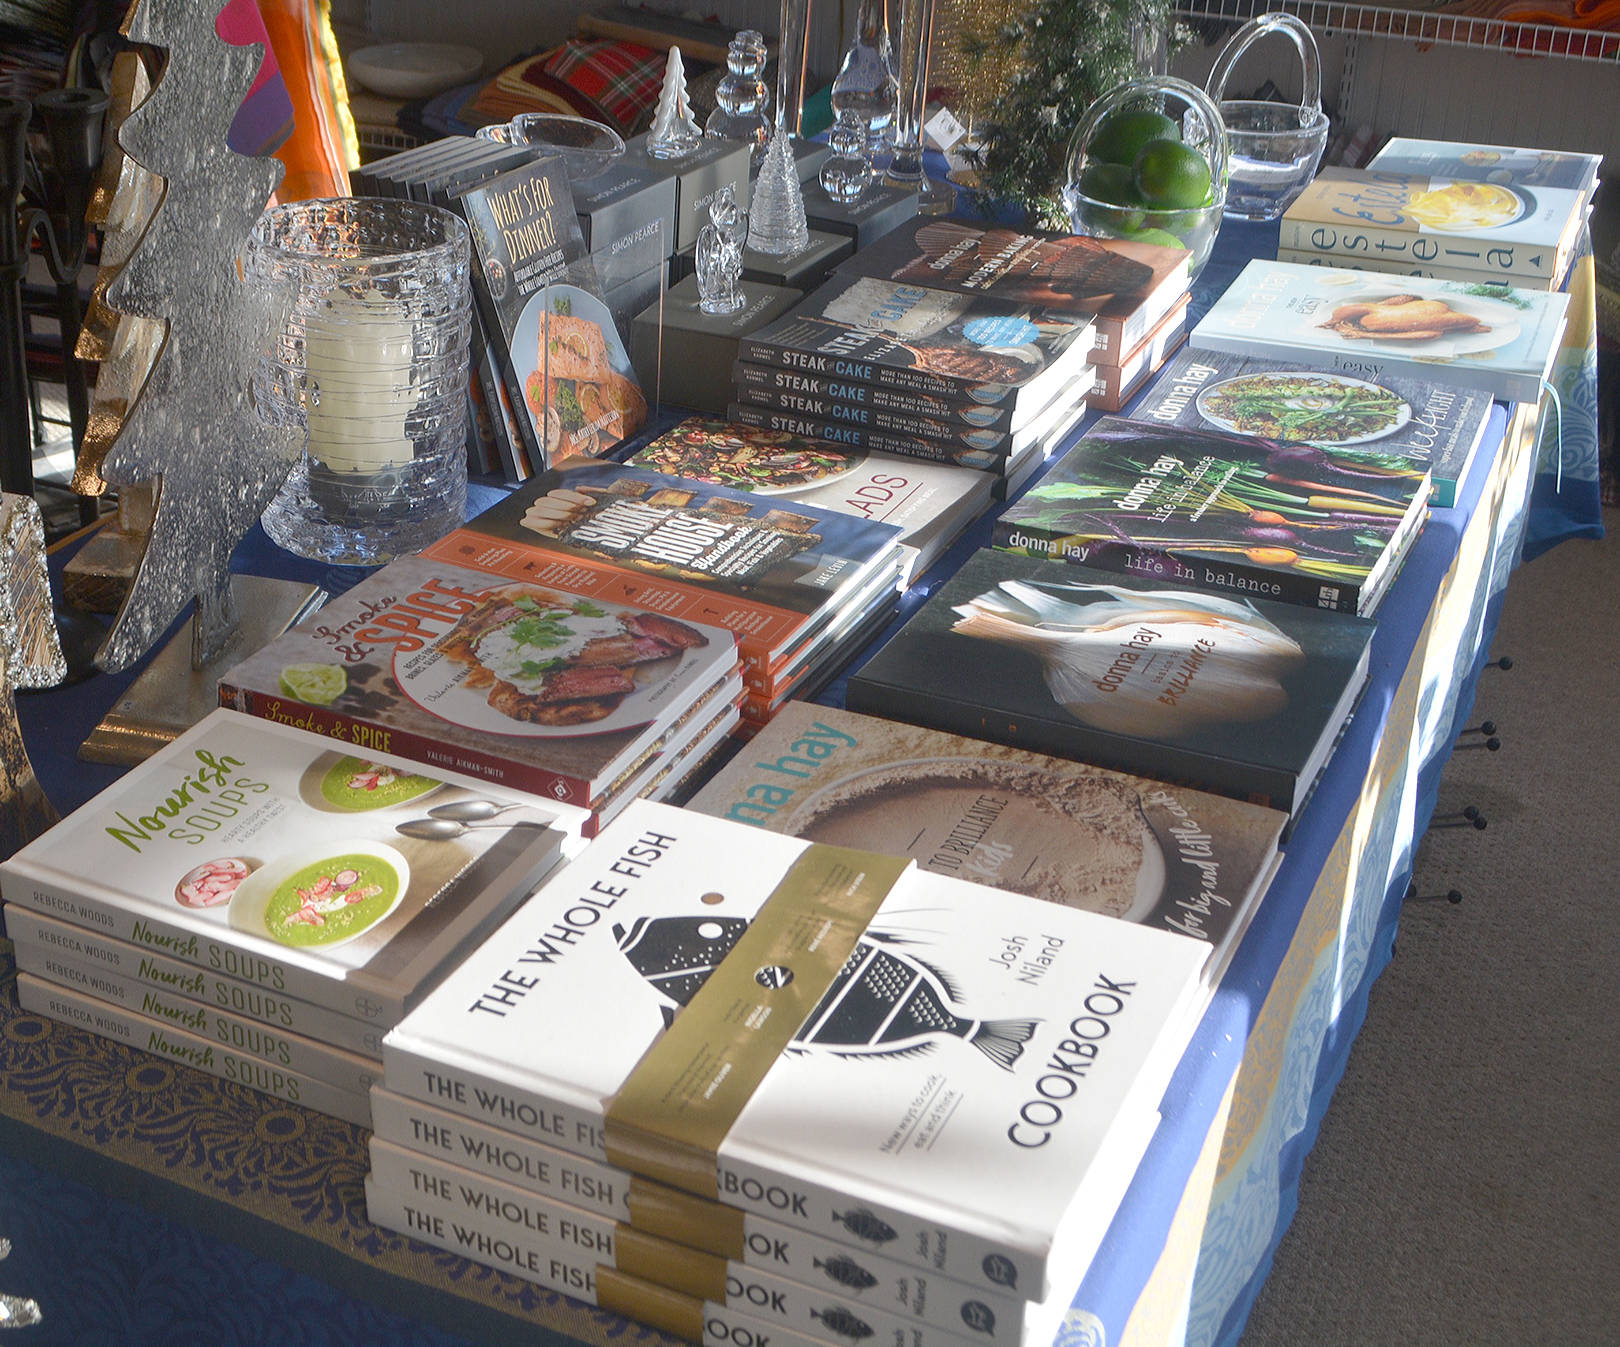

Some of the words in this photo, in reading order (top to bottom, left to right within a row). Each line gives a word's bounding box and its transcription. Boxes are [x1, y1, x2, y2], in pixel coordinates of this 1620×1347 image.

[486, 183, 533, 232] WHAT'S
[530, 176, 554, 212] FOR
[503, 210, 556, 265] DINNER?
[611, 235, 633, 255] SIMON
[633, 221, 661, 242] PEARCE
[1311, 228, 1514, 269] estela
[961, 257, 1004, 288] MODERN
[997, 235, 1034, 259] BAKING
[817, 321, 884, 355] STEAK
[870, 287, 928, 321] CAKE
[750, 346, 775, 356] ELIZABETH
[782, 351, 827, 371] STEAK
[836, 361, 873, 380] CAKE
[1341, 358, 1384, 376] easy
[775, 374, 820, 393] STEAK
[828, 383, 866, 402] CAKE
[880, 369, 896, 378] MORE
[897, 372, 912, 380] THAN
[912, 374, 922, 382] 100
[924, 376, 947, 386] RECIPES
[880, 376, 895, 384] MAKE
[896, 378, 906, 386] ANY
[908, 380, 922, 388] MEAL
[928, 384, 947, 393] SMASH
[1172, 362, 1219, 386] hay
[780, 394, 823, 414] STEAK
[832, 405, 868, 424] CAKE
[873, 398, 888, 406] MAKE
[888, 400, 900, 408] ANY
[900, 403, 915, 412] MEAL
[922, 407, 940, 416] SMASH
[874, 392, 889, 400] MORE
[890, 394, 904, 402] THAN
[906, 396, 916, 404] 100
[917, 398, 940, 408] RECIPES
[940, 402, 948, 410] TO
[1147, 385, 1198, 421] donna
[1422, 388, 1456, 421] LIGHT
[771, 416, 815, 436] STEAK
[824, 426, 861, 445] CAKE
[876, 414, 892, 422] MORE
[892, 416, 906, 424] THAN
[908, 419, 918, 427] 100
[942, 426, 950, 434] TO
[1399, 410, 1439, 461] week
[1112, 477, 1162, 511] donna
[1140, 455, 1184, 477] hay
[1175, 455, 1215, 491] balance
[845, 474, 908, 519] ADS
[1147, 504, 1176, 523] life
[1166, 492, 1187, 503] in
[571, 500, 674, 549] SMOKE
[630, 512, 735, 565] HOUSE
[690, 526, 752, 570] Handbook
[1009, 531, 1060, 555] donna
[1062, 539, 1090, 562] hay
[814, 573, 830, 586] JAKE
[830, 560, 848, 578] LEVIN
[1124, 554, 1164, 574] life
[1174, 560, 1196, 580] in
[1204, 563, 1282, 596] balance
[312, 595, 398, 645] Smoke
[353, 577, 497, 652] SPICE
[1091, 651, 1141, 693] donna
[1120, 627, 1163, 651] hay
[1157, 638, 1216, 707] BRILLIANCE
[264, 700, 324, 734] Smoke
[329, 722, 348, 740] &
[352, 724, 393, 753] SPICE
[426, 750, 453, 765] VALERIE
[455, 758, 505, 778] AIKMAN-SMITH
[755, 721, 857, 778] hay
[105, 749, 246, 854] Nourish
[168, 778, 270, 845] SOUPS
[940, 794, 1009, 863] BRILLIANCE
[1168, 820, 1213, 857] little
[928, 850, 963, 871] TO
[1180, 858, 1220, 890] and
[33, 891, 77, 914] REBECCA
[78, 906, 115, 928] WOODS
[1175, 888, 1232, 916] big
[467, 969, 541, 1018] THE
[518, 880, 629, 965] WHOLE
[609, 830, 678, 878] FISH
[1164, 911, 1208, 939] for
[38, 929, 82, 953] REBECCA
[83, 943, 121, 966] WOODS
[131, 920, 199, 959] Nourish
[208, 944, 286, 991] SOUPS
[988, 934, 1029, 971] Josh
[1016, 934, 1065, 986] Niland
[46, 960, 88, 984] REBECCA
[89, 974, 126, 1000] WOODS
[138, 957, 206, 995] Nourish
[215, 981, 294, 1028] SOUPS
[49, 1000, 93, 1028] REBECCA
[94, 1013, 130, 1038] WOODS
[142, 992, 208, 1032] Nourish
[216, 1018, 292, 1066] SOUPS
[148, 1030, 215, 1070] Nourish
[224, 1056, 300, 1102] SOUPS
[1007, 973, 1138, 1149] COOKBOOK
[423, 1071, 466, 1105] THE
[474, 1088, 566, 1138] WHOLE
[576, 1122, 606, 1150] FIS
[409, 1118, 452, 1150] THE
[459, 1134, 550, 1184] WHOLE
[560, 1171, 614, 1206] FISH
[409, 1168, 452, 1202] THE
[458, 1185, 550, 1234] WHOLE
[560, 1220, 612, 1256] FISH
[403, 1206, 446, 1240] THE
[452, 1222, 540, 1274] WHOLE
